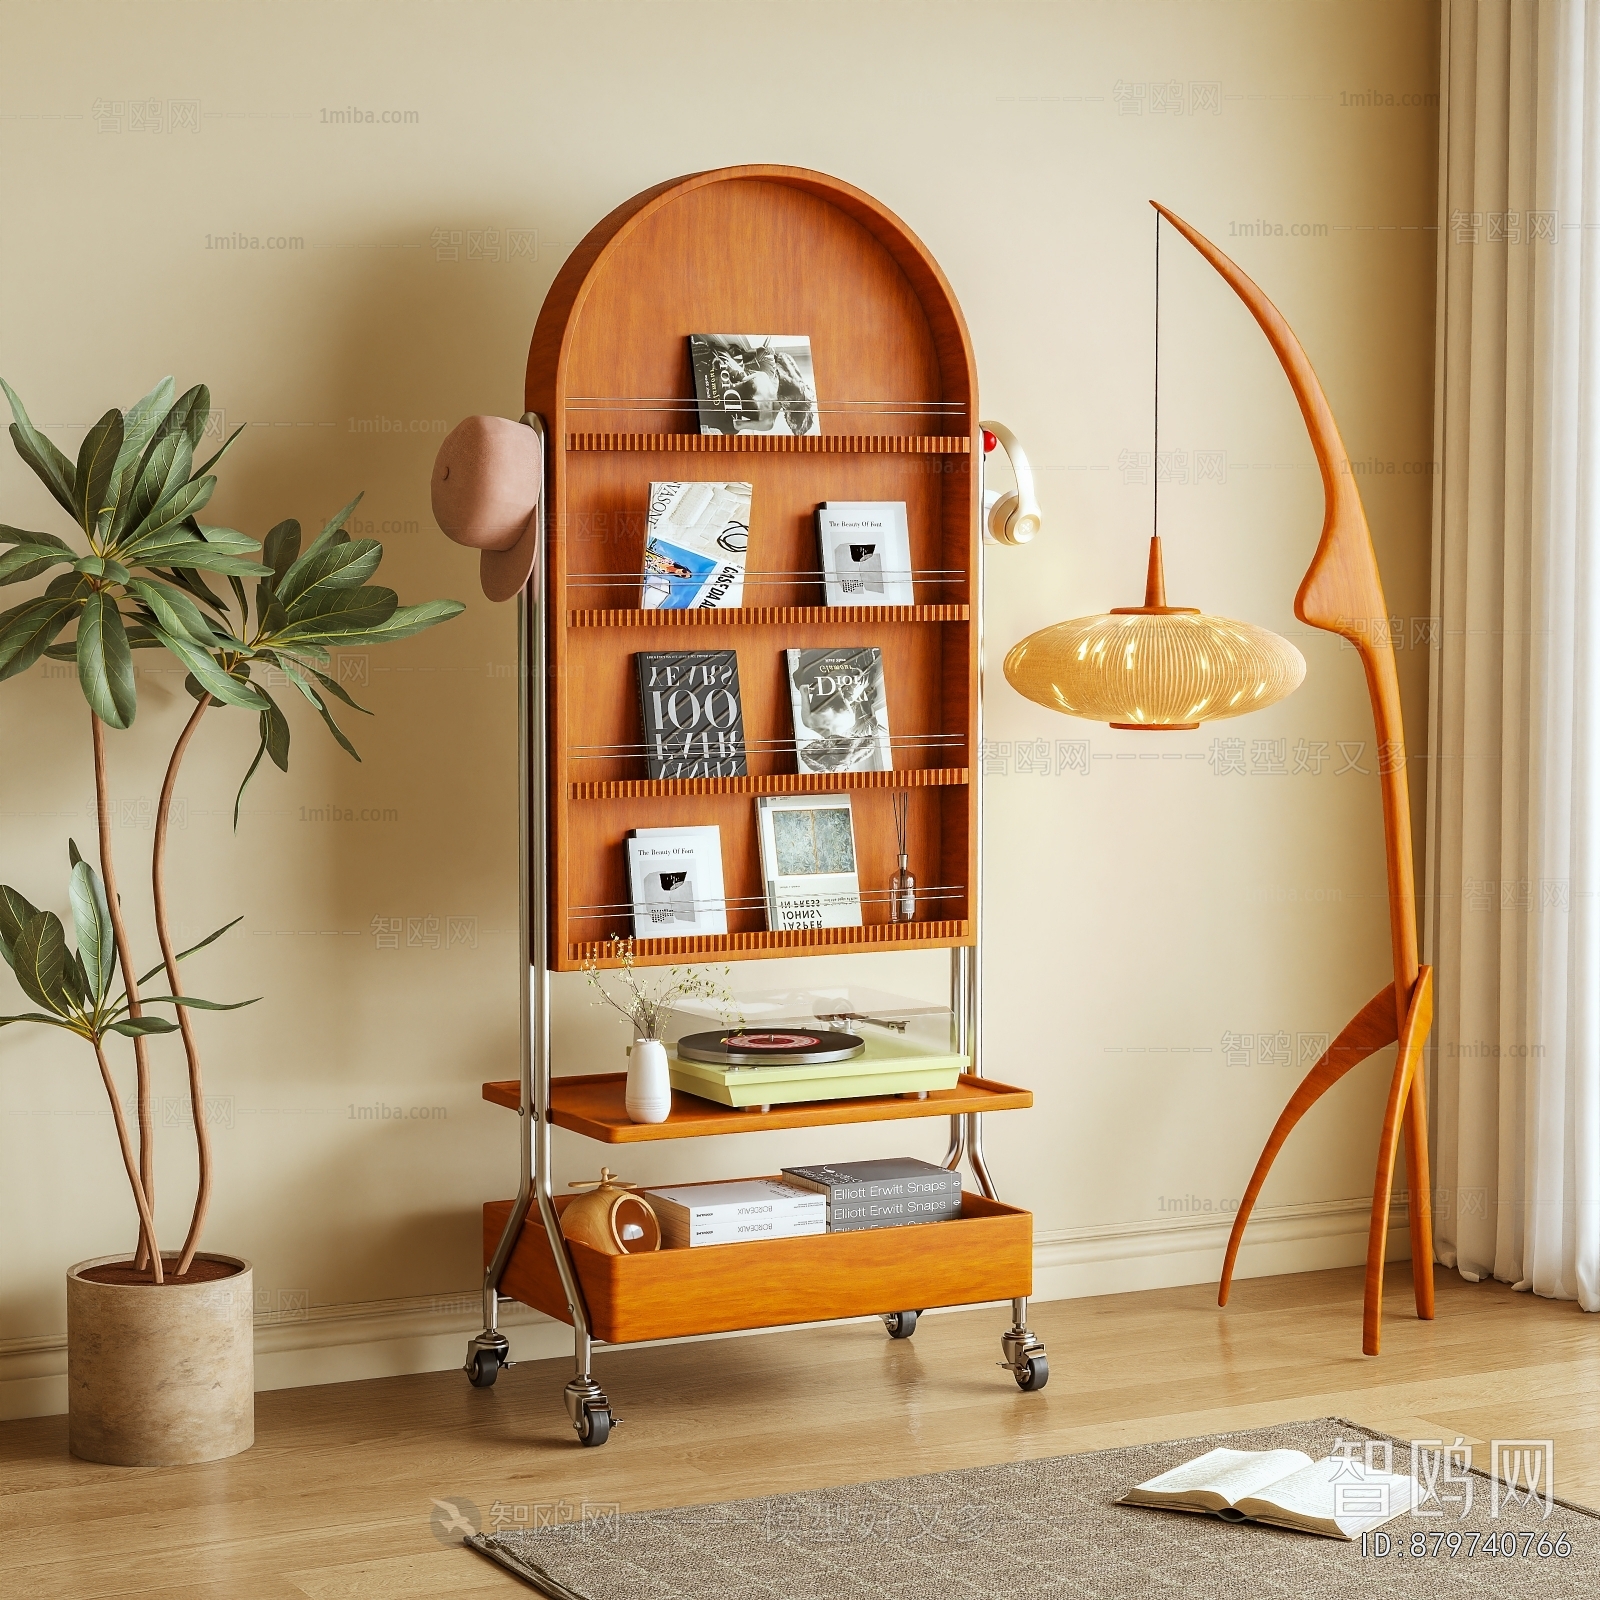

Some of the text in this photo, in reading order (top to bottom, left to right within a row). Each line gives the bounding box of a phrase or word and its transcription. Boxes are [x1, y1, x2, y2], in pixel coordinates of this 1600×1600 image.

[649, 482, 682, 526] VASONI
[841, 520, 860, 529] Beauty
[651, 848, 671, 857] Beauty
[672, 847, 680, 855] Of
[834, 1187, 866, 1201] Elliott
[870, 1184, 904, 1197] Erwitt
[907, 1180, 947, 1194] Snaps
[737, 1205, 773, 1215] BORDEAUX
[834, 1199, 947, 1220] Elliott Erwitt Snaps
[737, 1223, 773, 1233] BORDEAUX
